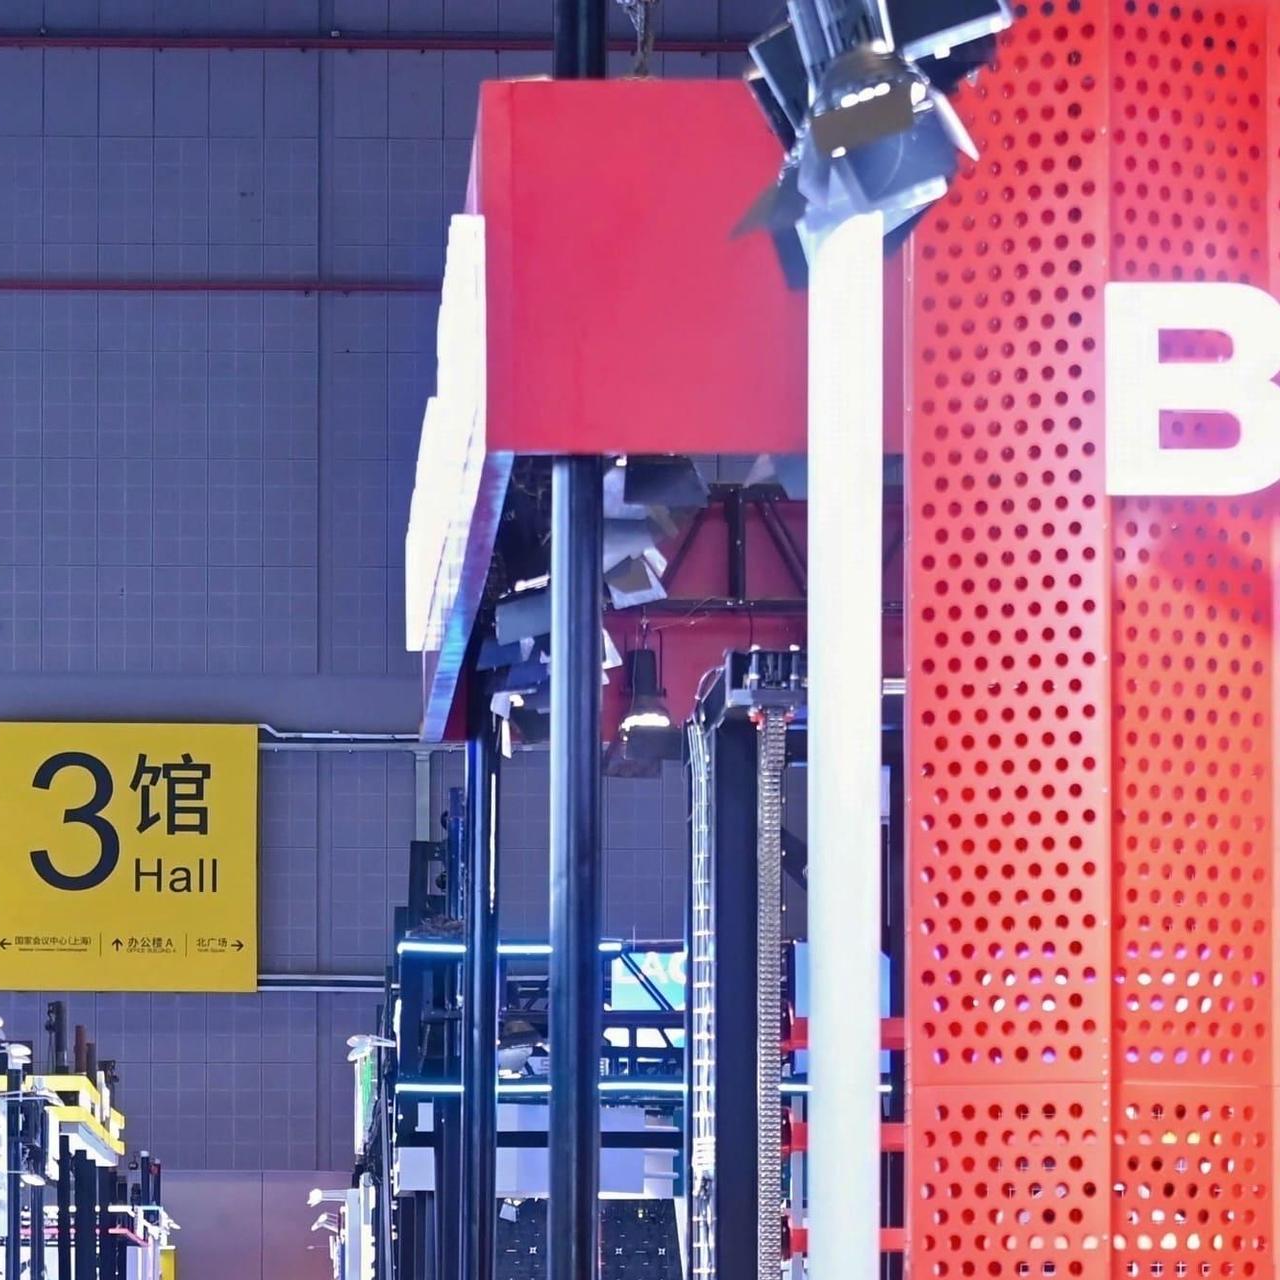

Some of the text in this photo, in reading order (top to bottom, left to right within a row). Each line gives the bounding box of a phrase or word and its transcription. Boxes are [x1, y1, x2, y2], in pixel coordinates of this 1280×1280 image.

[30, 752, 211, 891] 3 馆
[134, 858, 217, 893] Hall
[127, 937, 174, 949] 办公楼 A
[196, 938, 228, 948] 北广场
